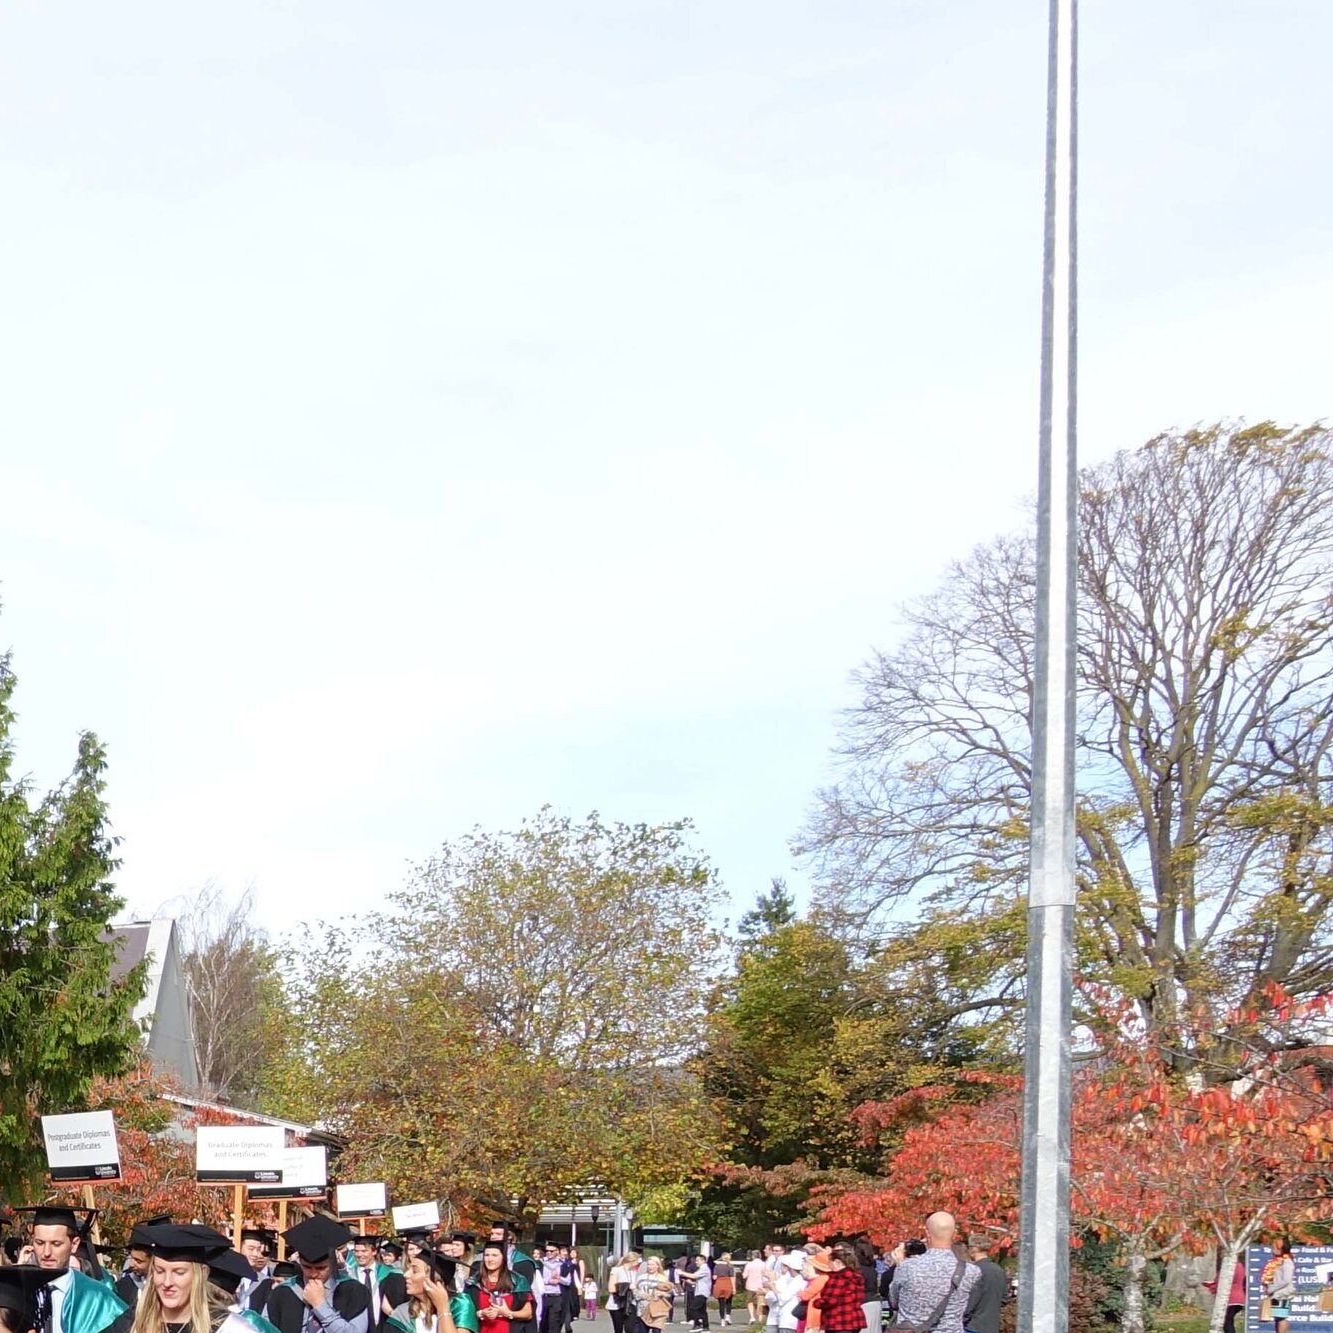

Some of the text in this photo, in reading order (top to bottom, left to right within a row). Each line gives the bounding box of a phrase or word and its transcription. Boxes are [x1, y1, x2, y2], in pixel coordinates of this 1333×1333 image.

[47, 1130, 111, 1142] Postgraduate Diplomas
[59, 1142, 101, 1151] and Certificates
[207, 1141, 273, 1150] Graduate Diplomas
